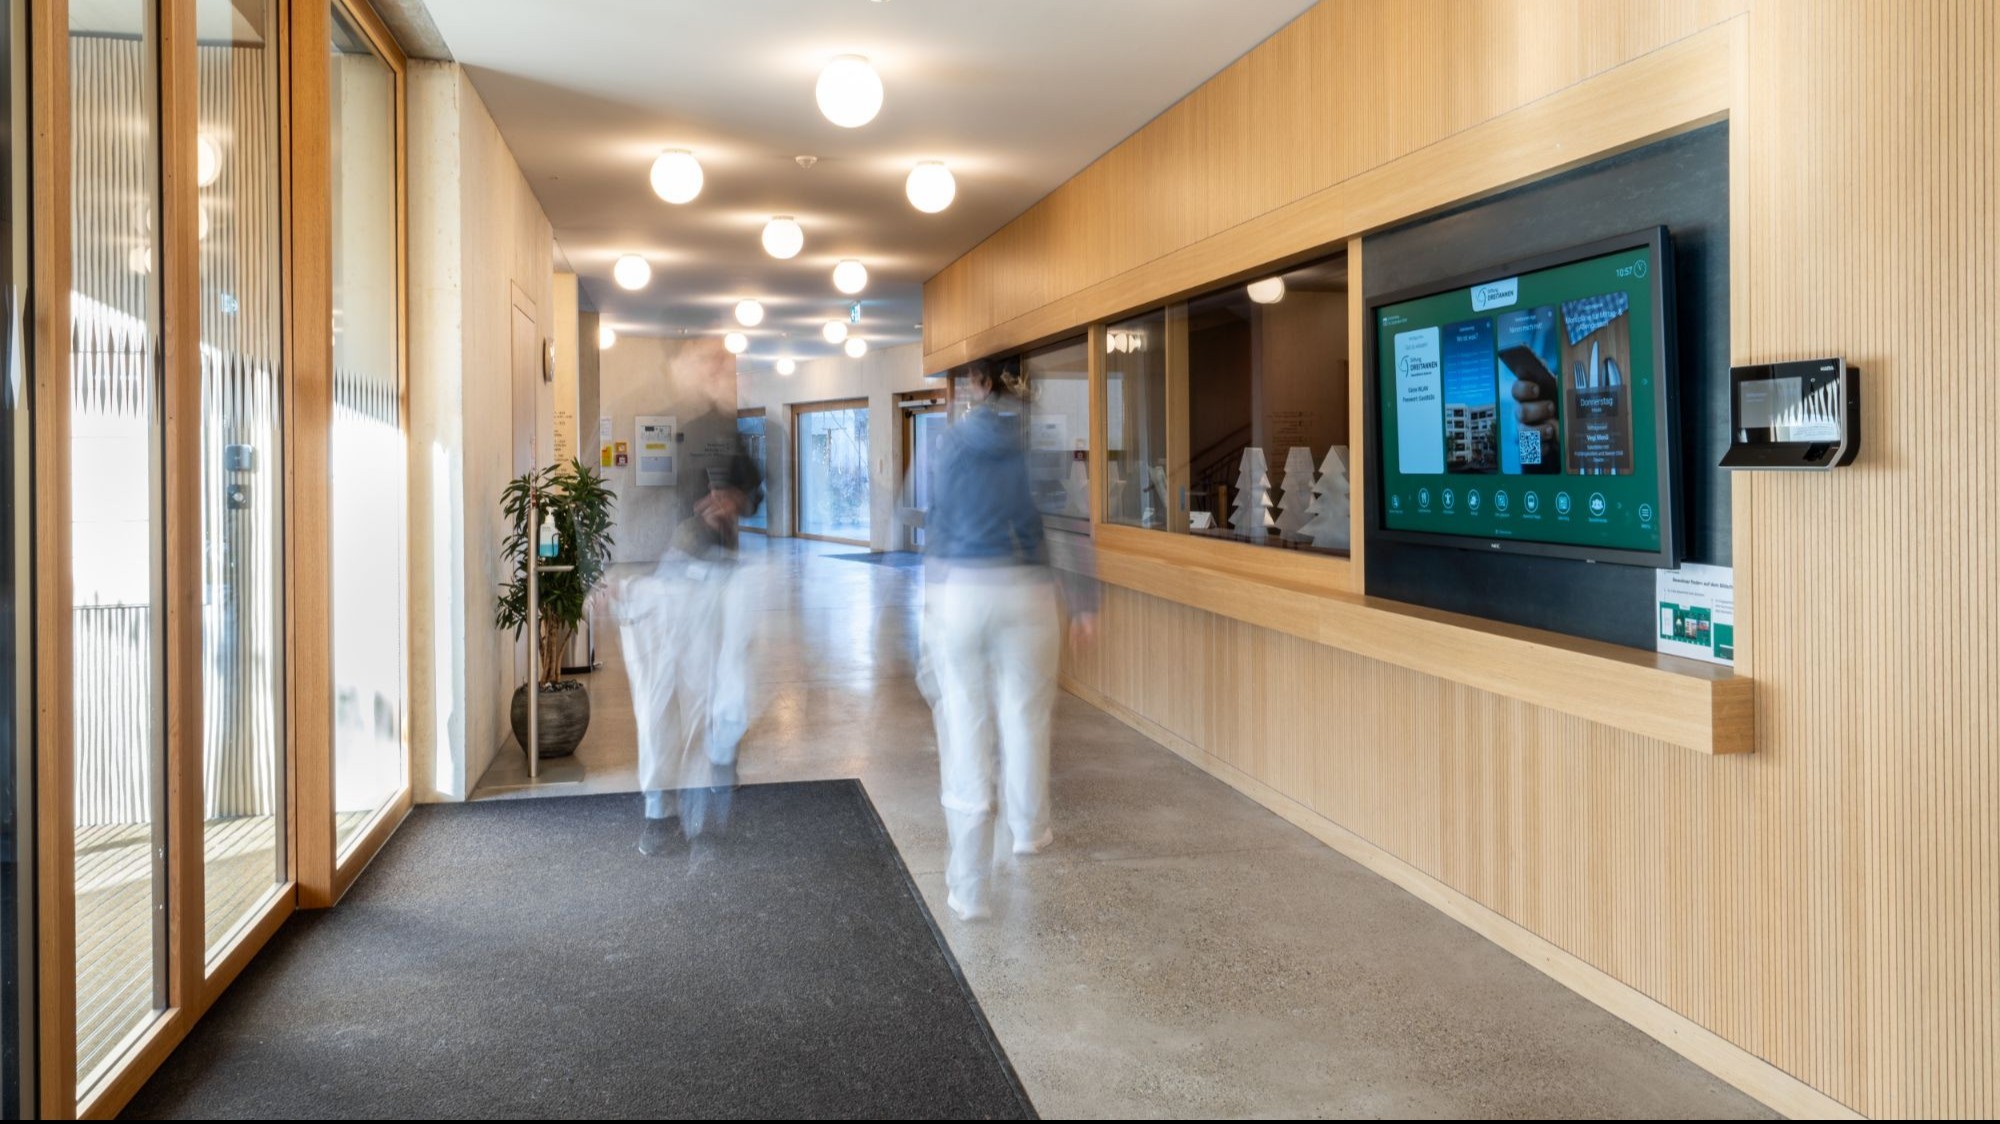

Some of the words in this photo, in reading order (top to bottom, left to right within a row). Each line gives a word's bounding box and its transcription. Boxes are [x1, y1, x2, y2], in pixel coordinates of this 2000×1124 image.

[1616, 266, 1633, 277] 10:57
[1410, 361, 1438, 371] DREITANNEN
[1581, 397, 1613, 407] Donnerstag
